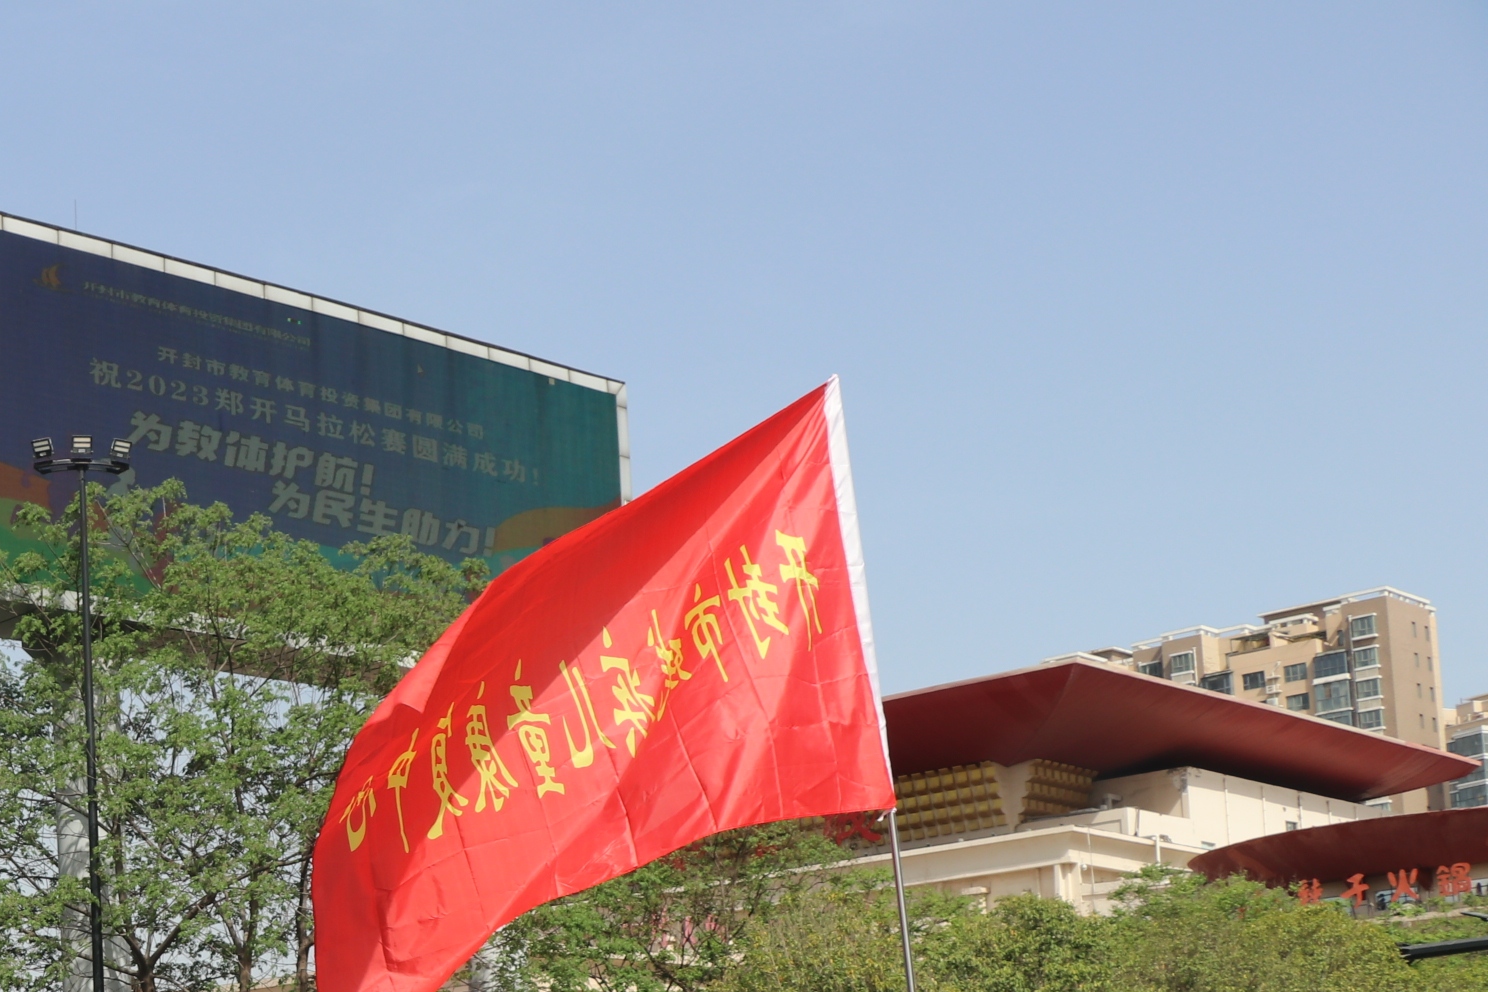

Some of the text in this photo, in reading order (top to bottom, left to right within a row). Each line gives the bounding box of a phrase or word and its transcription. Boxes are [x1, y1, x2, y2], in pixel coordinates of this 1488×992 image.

[157, 345, 486, 440] 开封市教育体育投资集团有限公司
